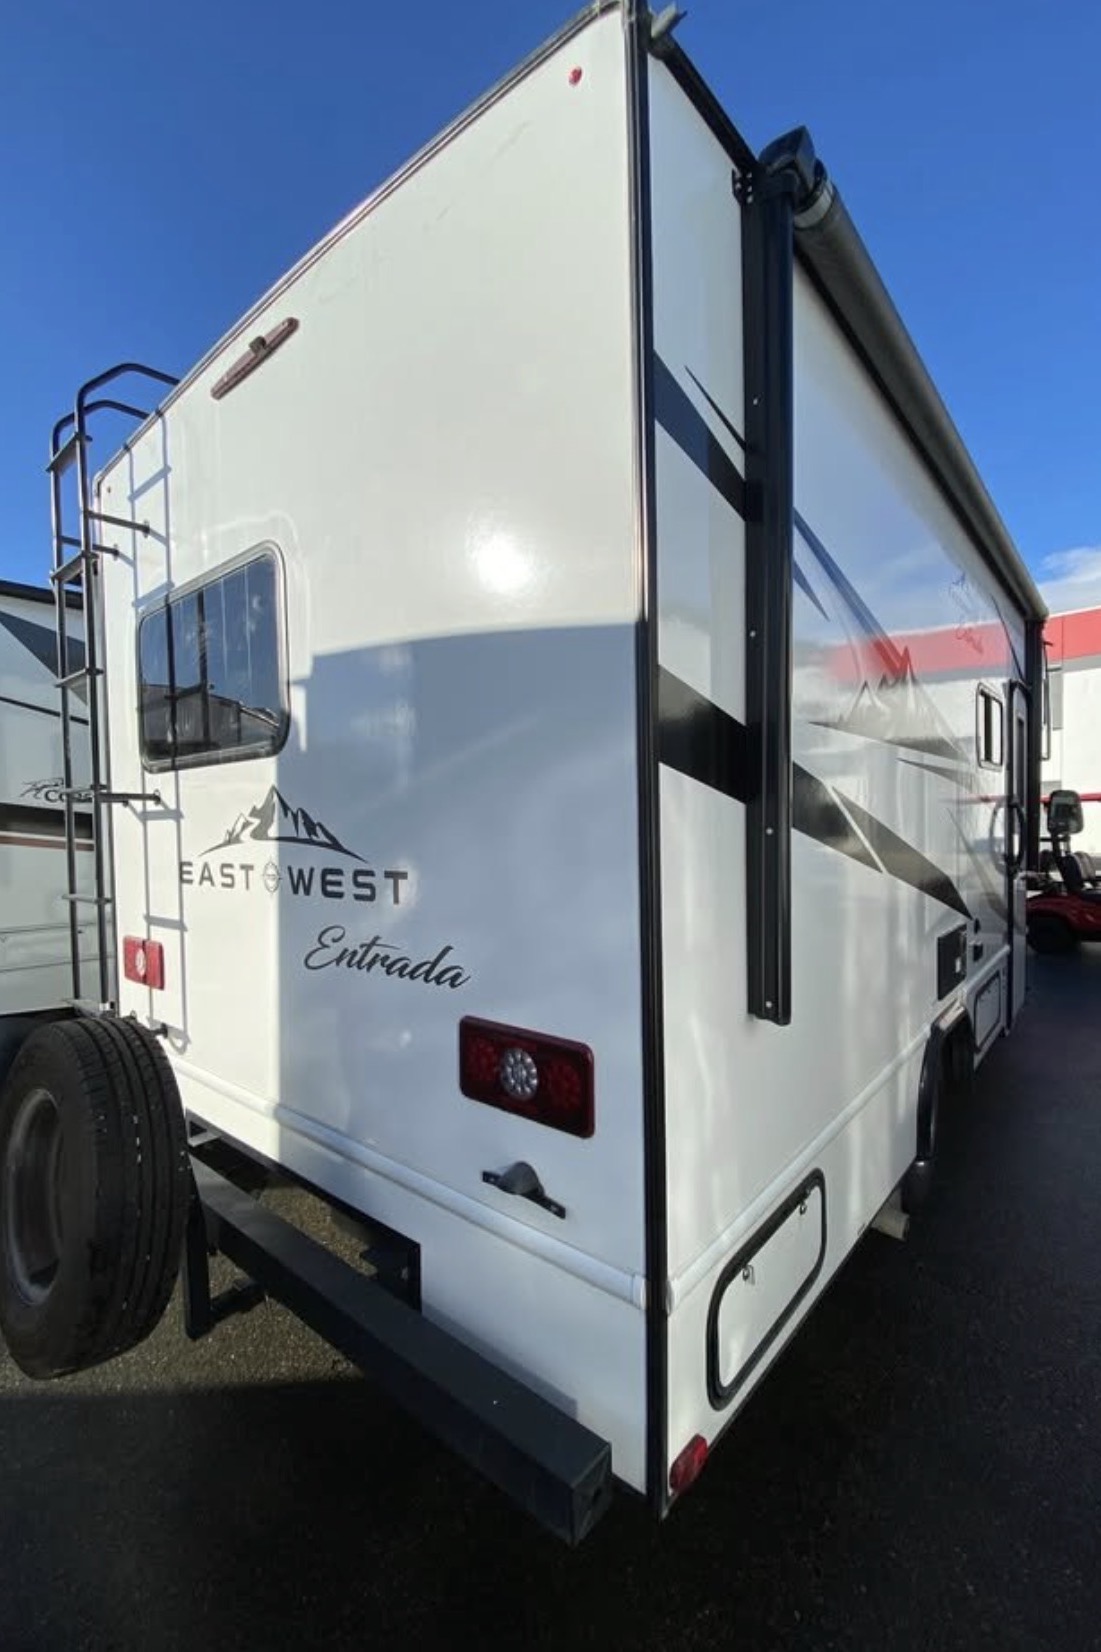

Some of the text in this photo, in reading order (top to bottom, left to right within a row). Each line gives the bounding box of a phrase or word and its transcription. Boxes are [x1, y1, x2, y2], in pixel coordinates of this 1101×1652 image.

[179, 861, 408, 905] EAST WEST
[304, 925, 471, 989] Entrada
